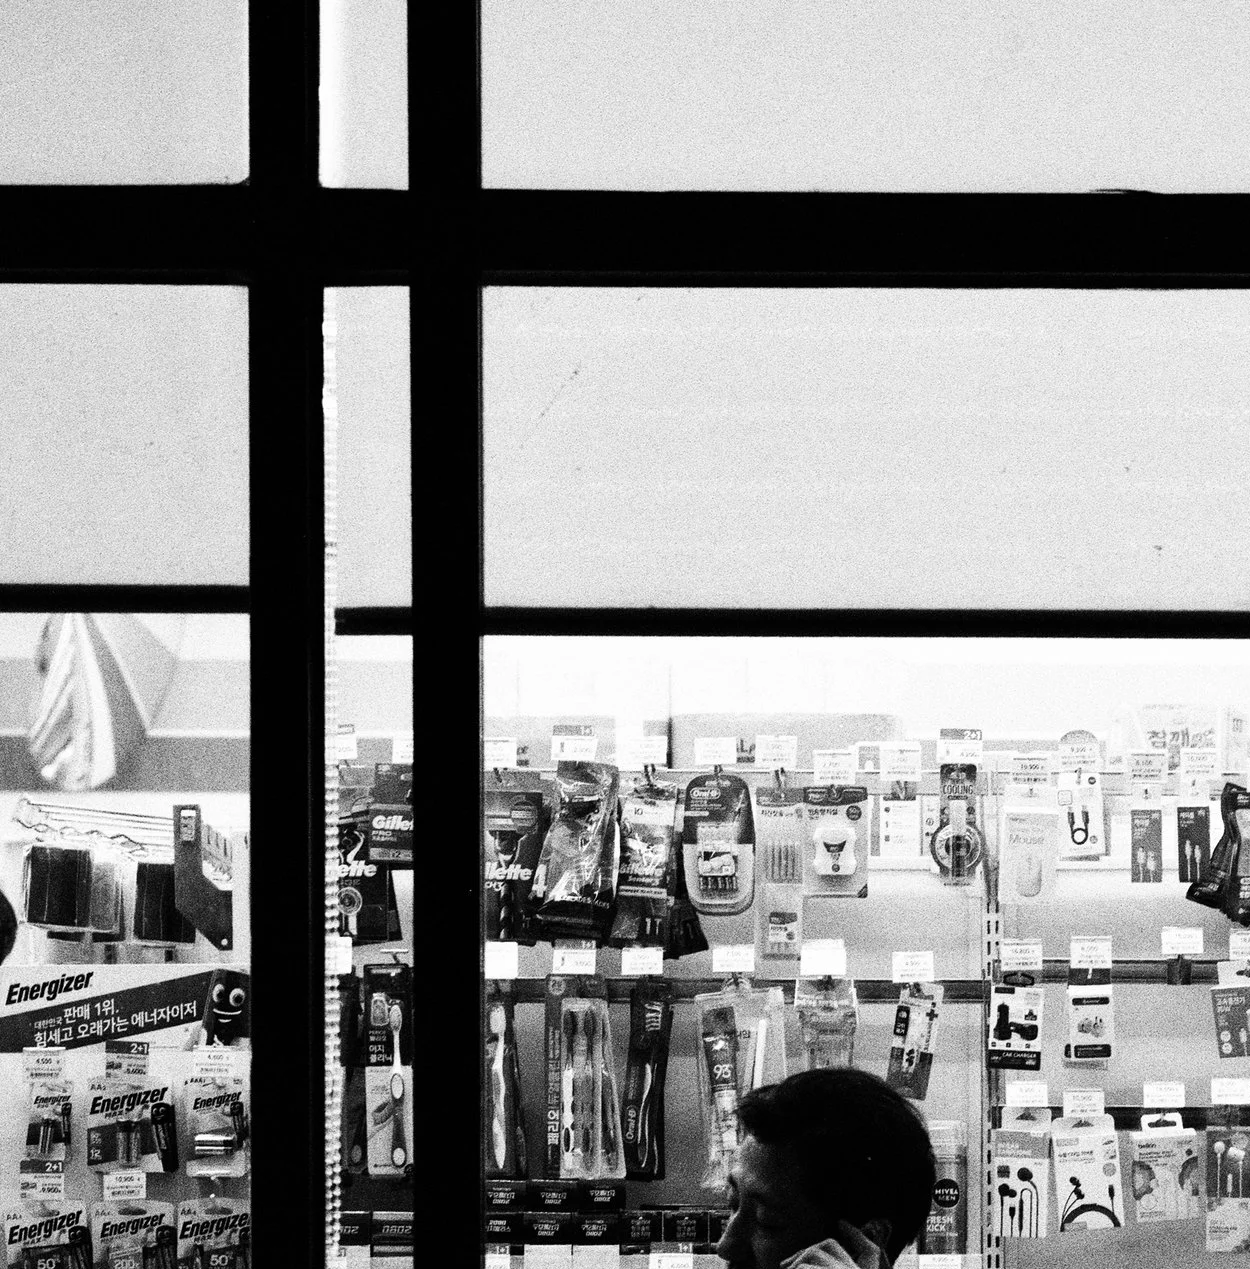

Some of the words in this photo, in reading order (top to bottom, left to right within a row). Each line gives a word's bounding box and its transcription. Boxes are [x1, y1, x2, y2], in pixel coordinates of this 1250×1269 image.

[5, 971, 94, 1006] Energizer
[34, 1016, 63, 1030] 대한민국
[64, 1007, 91, 1025] 판매
[94, 1000, 120, 1017] 1위.
[34, 1025, 73, 1049] 힘세고
[76, 1018, 129, 1040] 오래가는
[131, 1002, 198, 1028] 에너자이저
[131, 1043, 149, 1054] 2+1
[33, 1095, 72, 1106] Energizer
[89, 1087, 169, 1116] Energizer
[192, 1091, 242, 1111] Energizer
[547, 1109, 560, 1145] 페리오
[45, 1162, 63, 1172] 2+1
[8, 1210, 83, 1245] Energizer
[100, 1213, 166, 1239] Energizer
[179, 1212, 250, 1240] Energize
[926, 1216, 954, 1225] FRESH
[926, 1224, 947, 1232] KICK
